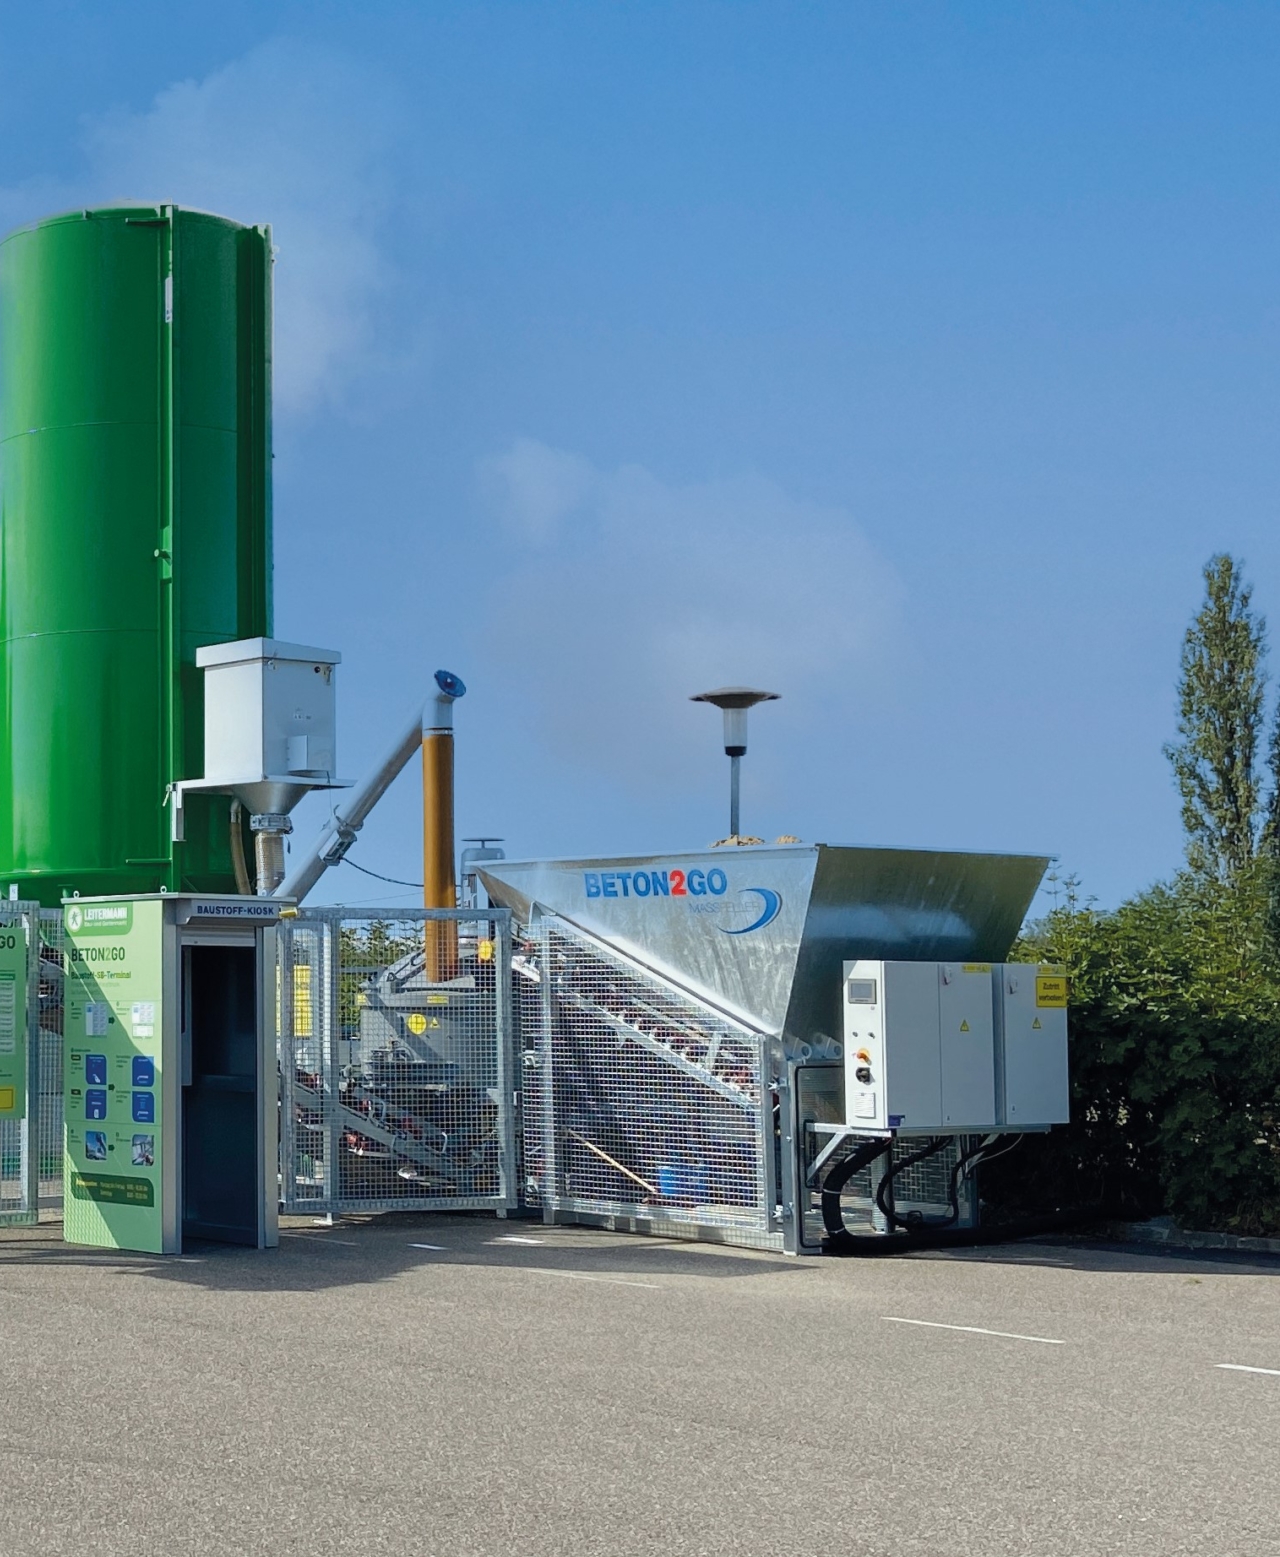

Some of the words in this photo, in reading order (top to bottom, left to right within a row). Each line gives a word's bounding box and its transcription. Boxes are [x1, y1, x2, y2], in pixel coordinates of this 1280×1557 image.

[584, 868, 728, 898] BETON2GO
[84, 907, 128, 920] LEITERMANN
[197, 905, 274, 915] BAUSTOFF-KIOSK
[71, 947, 125, 961] BETON2GO
[1043, 982, 1060, 990] Zutritt
